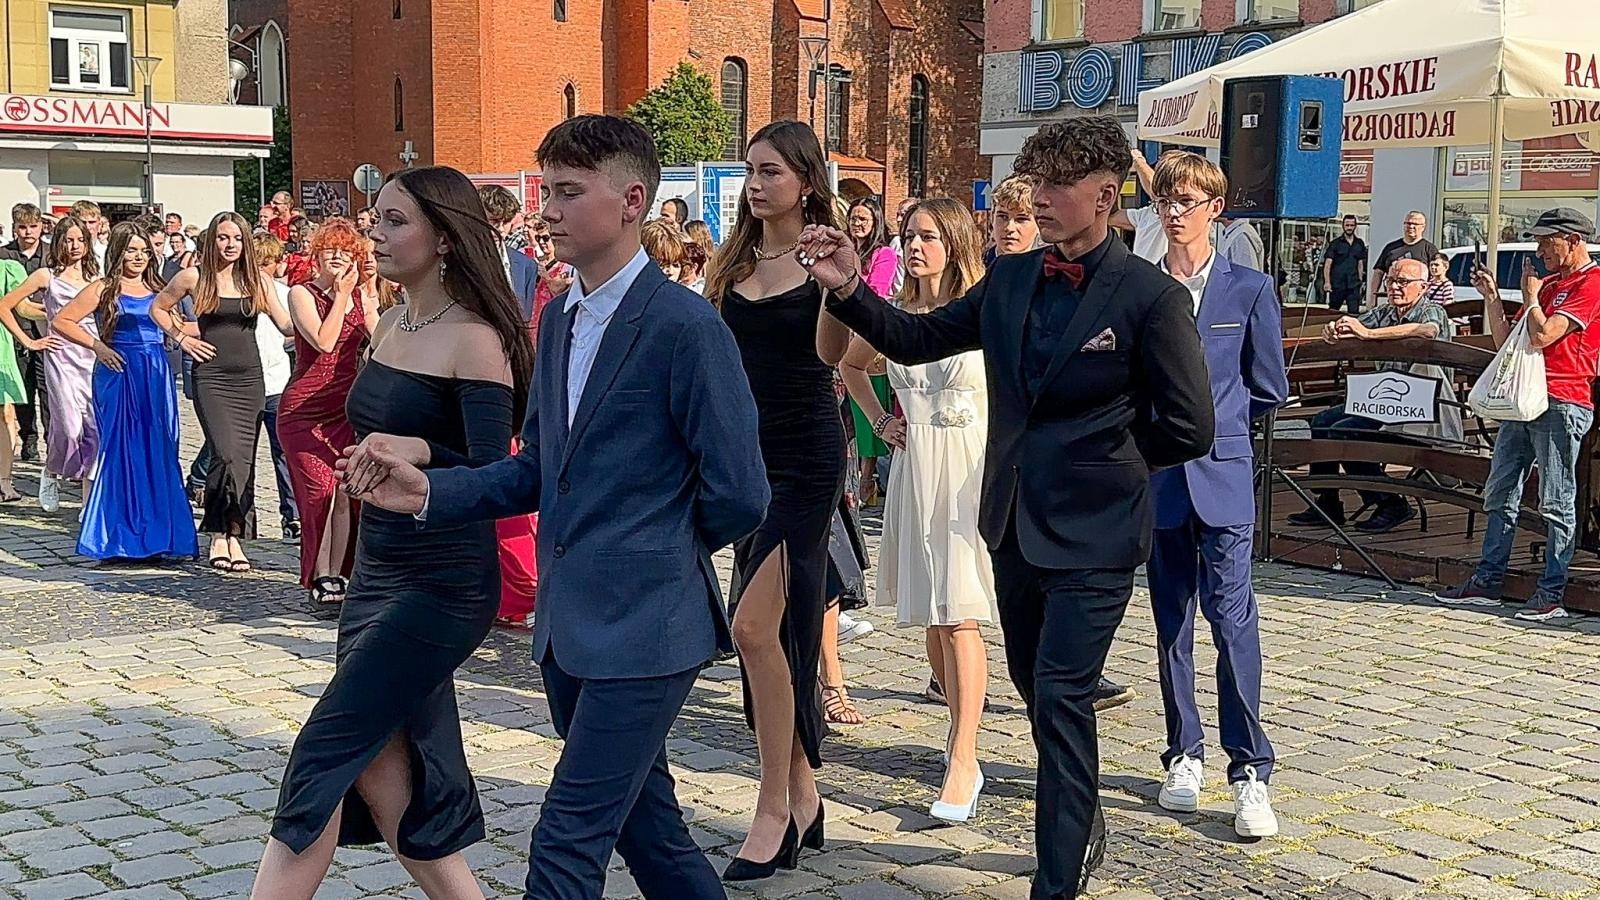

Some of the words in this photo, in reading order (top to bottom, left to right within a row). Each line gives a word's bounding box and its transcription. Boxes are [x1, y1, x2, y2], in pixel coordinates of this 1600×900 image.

[1303, 57, 1438, 103] ORSKIE
[0, 96, 170, 127] OSSMANN
[1352, 402, 1426, 419] RACIBORSKA
